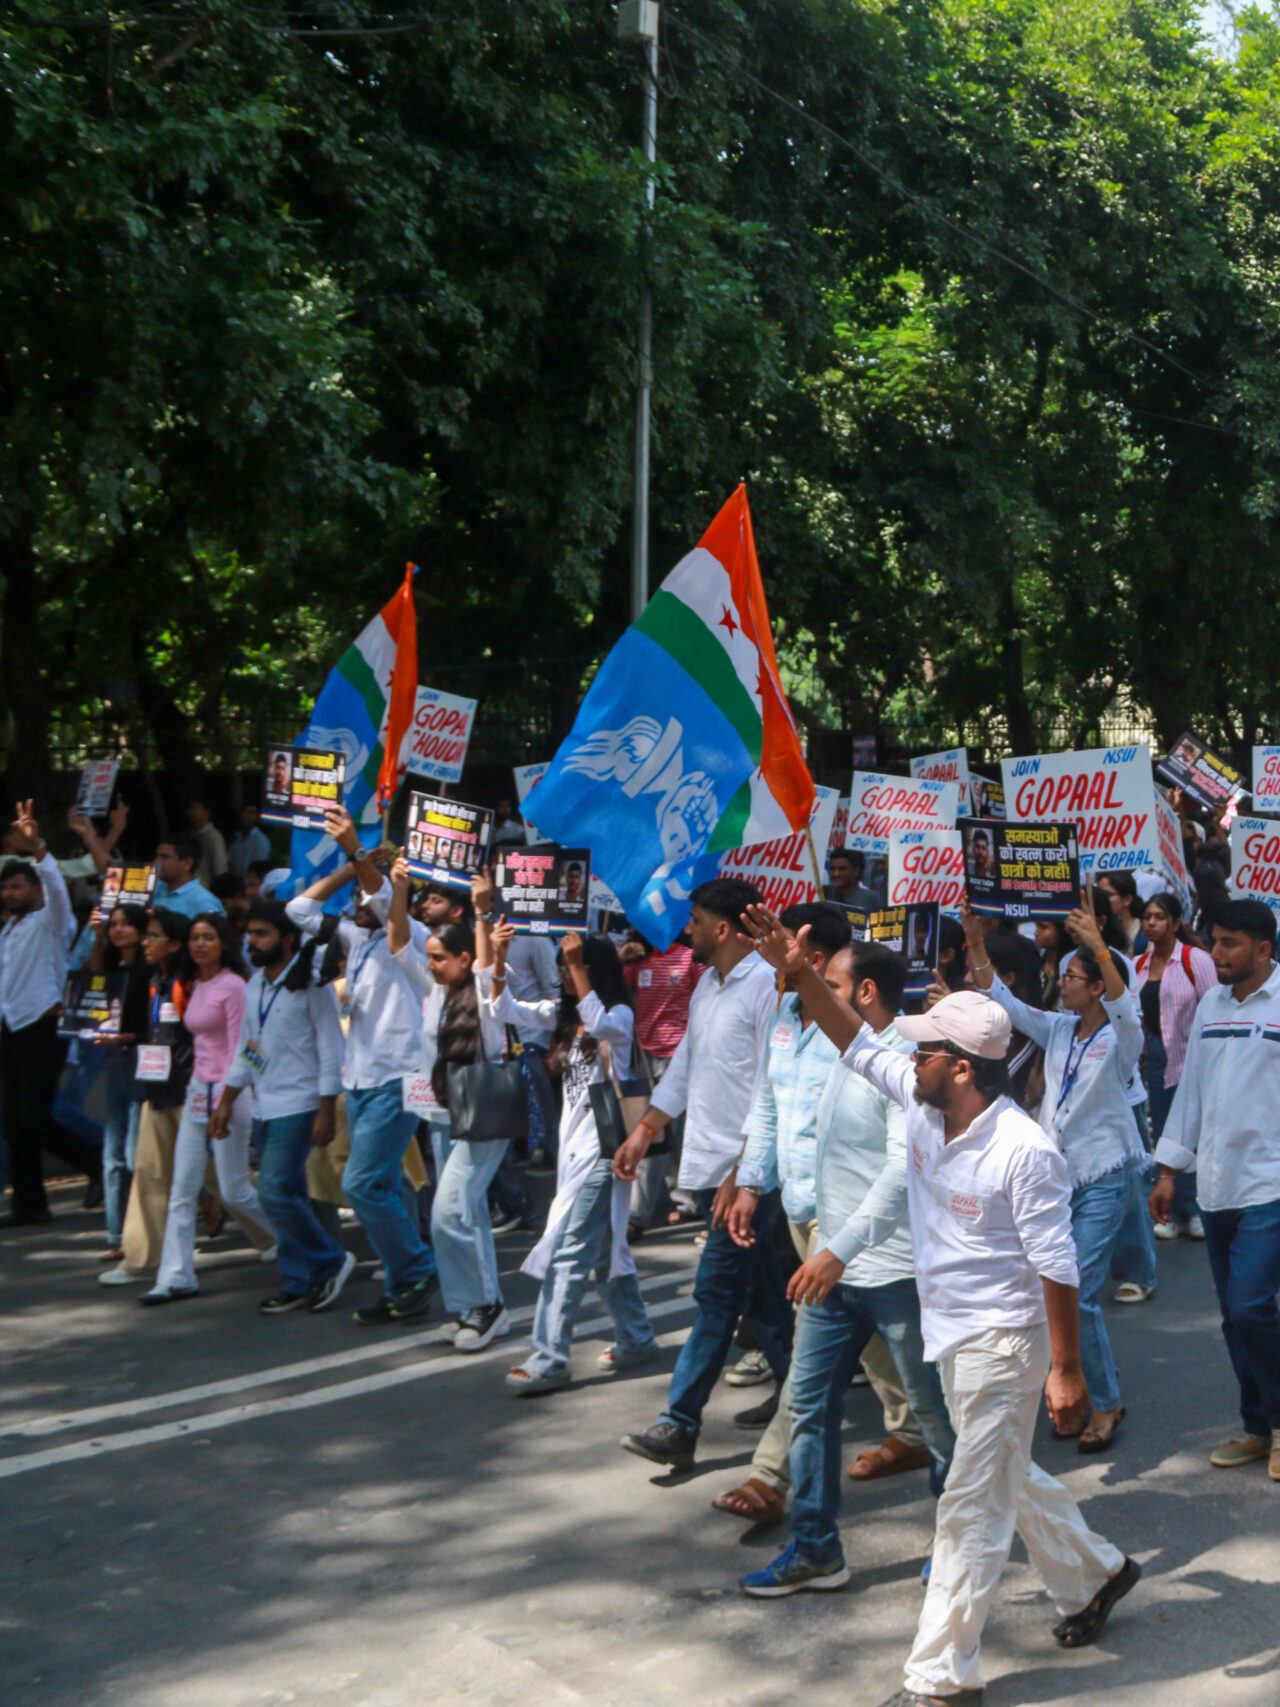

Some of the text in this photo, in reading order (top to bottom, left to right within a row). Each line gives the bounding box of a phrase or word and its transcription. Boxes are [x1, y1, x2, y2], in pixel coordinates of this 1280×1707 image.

[1012, 748, 1138, 778] JOIN NSUI
[860, 786, 940, 817] GOPAAL
[1015, 770, 1124, 818] GOPAAL
[1240, 818, 1268, 831] JOIN
[900, 833, 925, 845] JOIN
[1098, 850, 1154, 870] GOPAAL
[1039, 881, 1072, 893] Campus
[1004, 903, 1029, 917] NSUI
